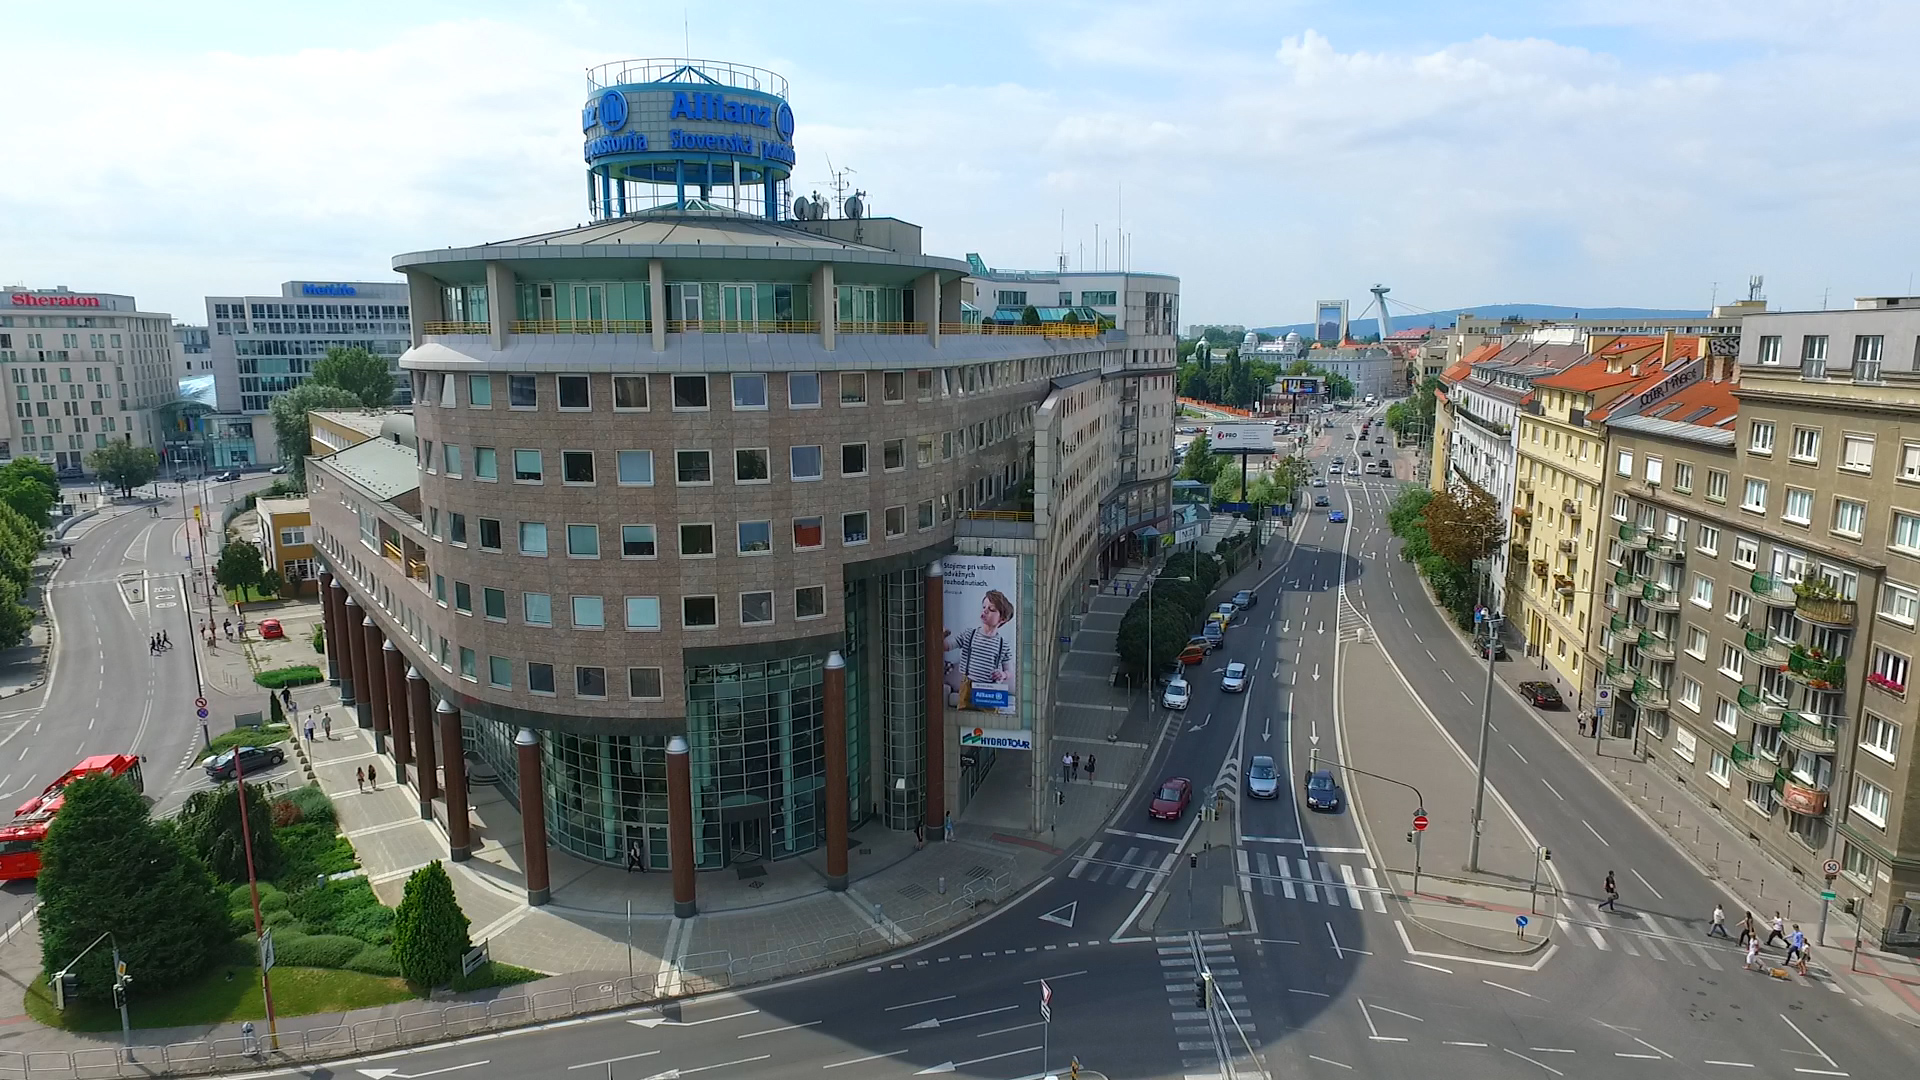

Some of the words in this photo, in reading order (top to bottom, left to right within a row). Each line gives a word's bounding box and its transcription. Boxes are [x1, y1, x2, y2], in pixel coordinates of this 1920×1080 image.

[670, 91, 772, 128] Allianz
[670, 129, 753, 154] Slovenská
[302, 282, 356, 297] MetLife
[11, 292, 100, 307] Sheraton
[967, 563, 976, 571] pri
[980, 736, 1030, 750] HYDROTOUR
[1827, 863, 1837, 872] 50
